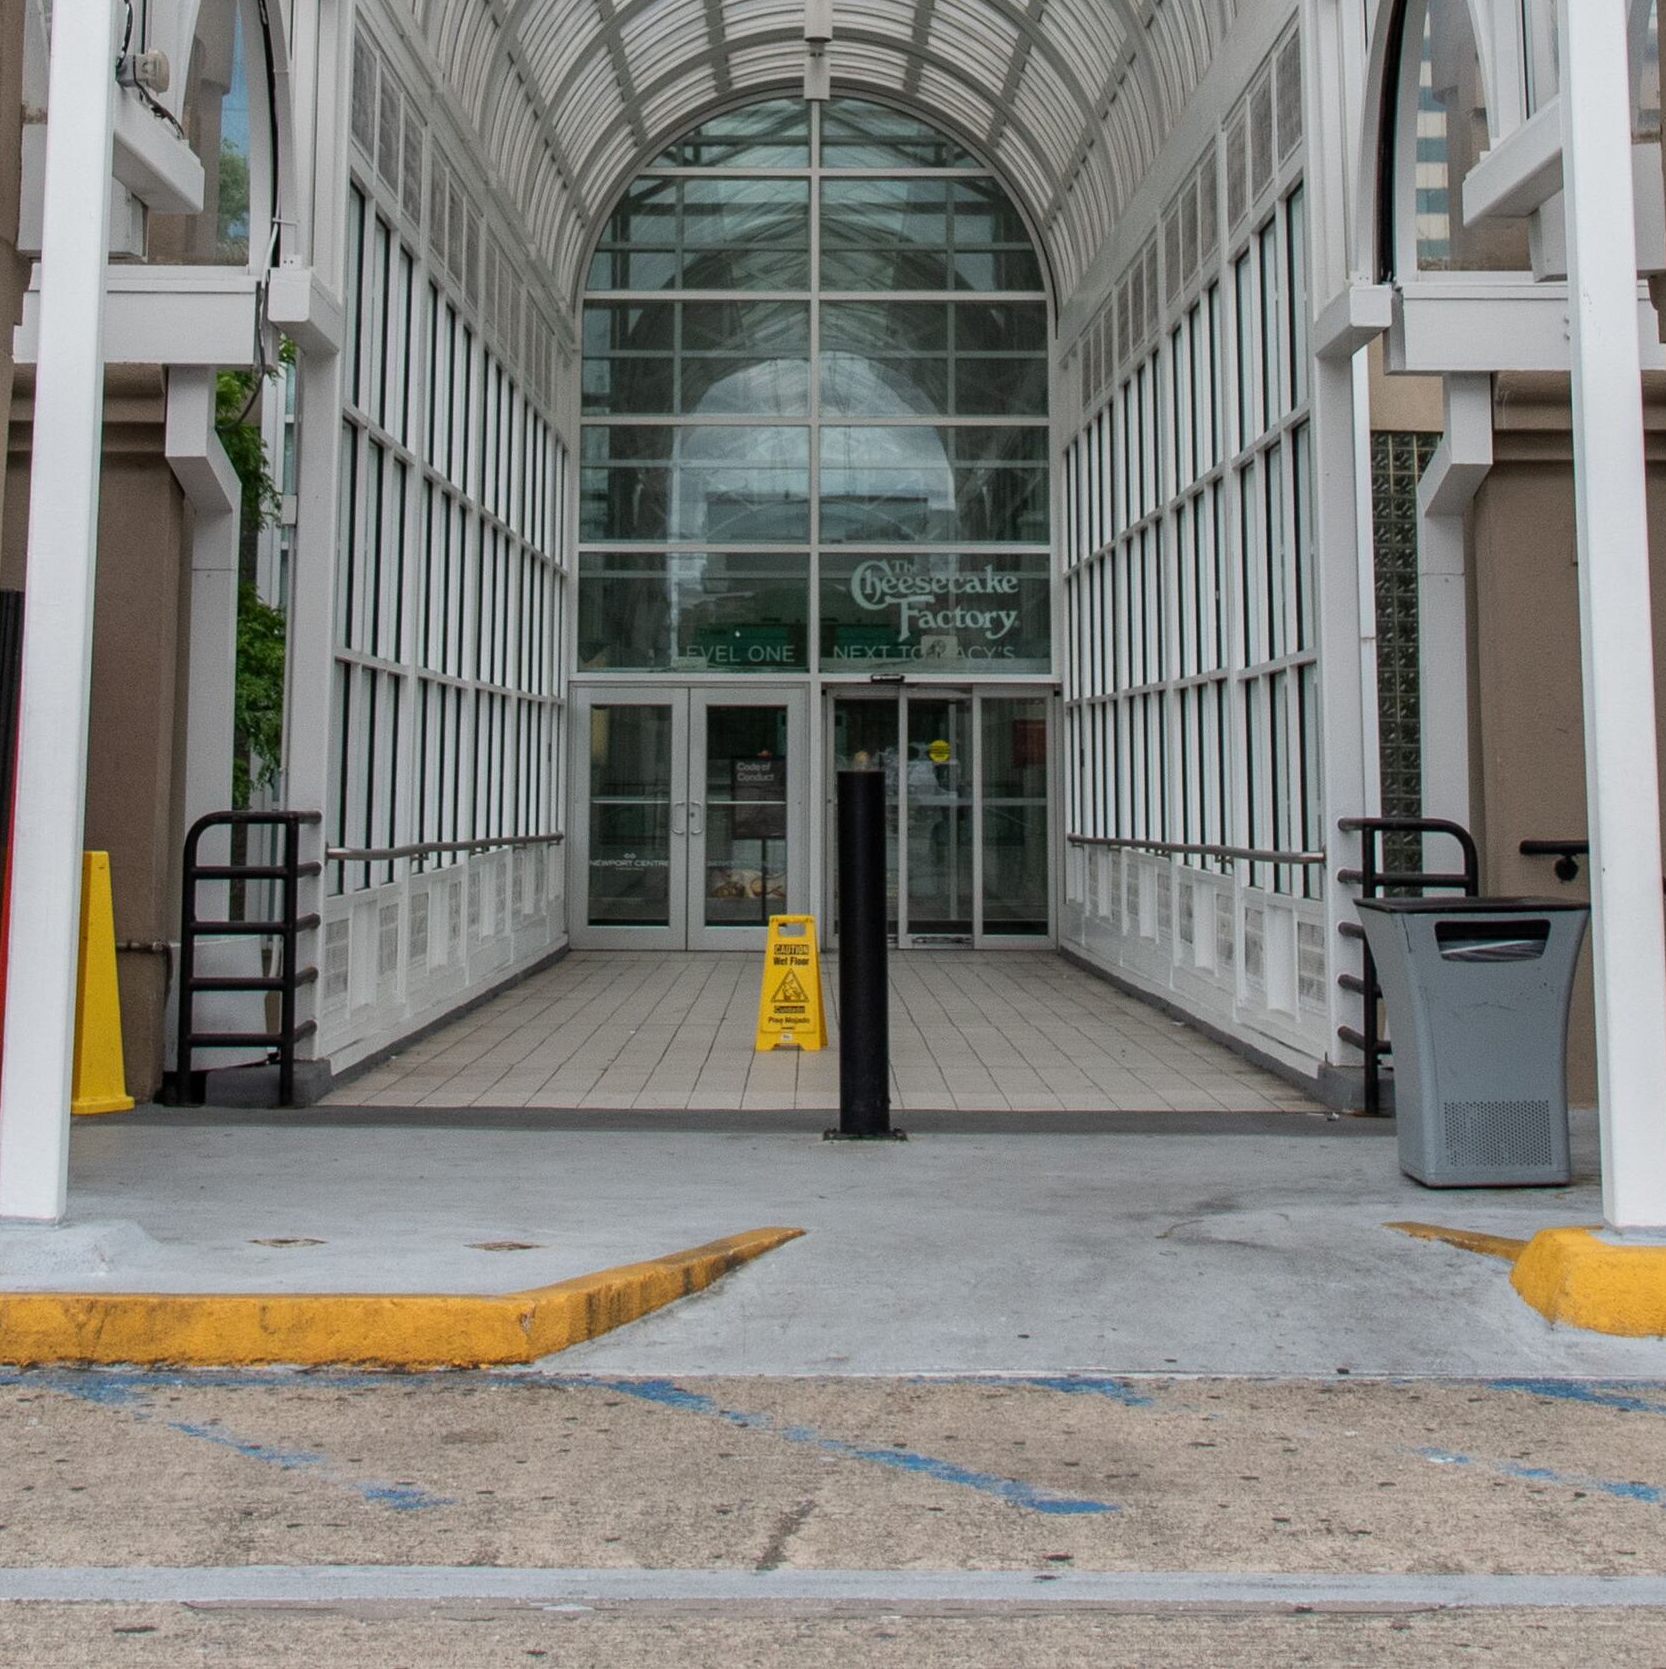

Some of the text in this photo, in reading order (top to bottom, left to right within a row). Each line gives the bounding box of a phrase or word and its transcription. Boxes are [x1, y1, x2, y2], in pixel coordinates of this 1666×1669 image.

[851, 559, 1019, 610] Cheesecake
[885, 595, 1018, 642] Factory
[676, 645, 795, 662] EVEL ONE
[834, 645, 890, 659] NEXT
[736, 762, 760, 771] Code
[736, 772, 774, 782] Conduct
[774, 944, 809, 955] CAUTION
[773, 956, 810, 965] Wet Floor
